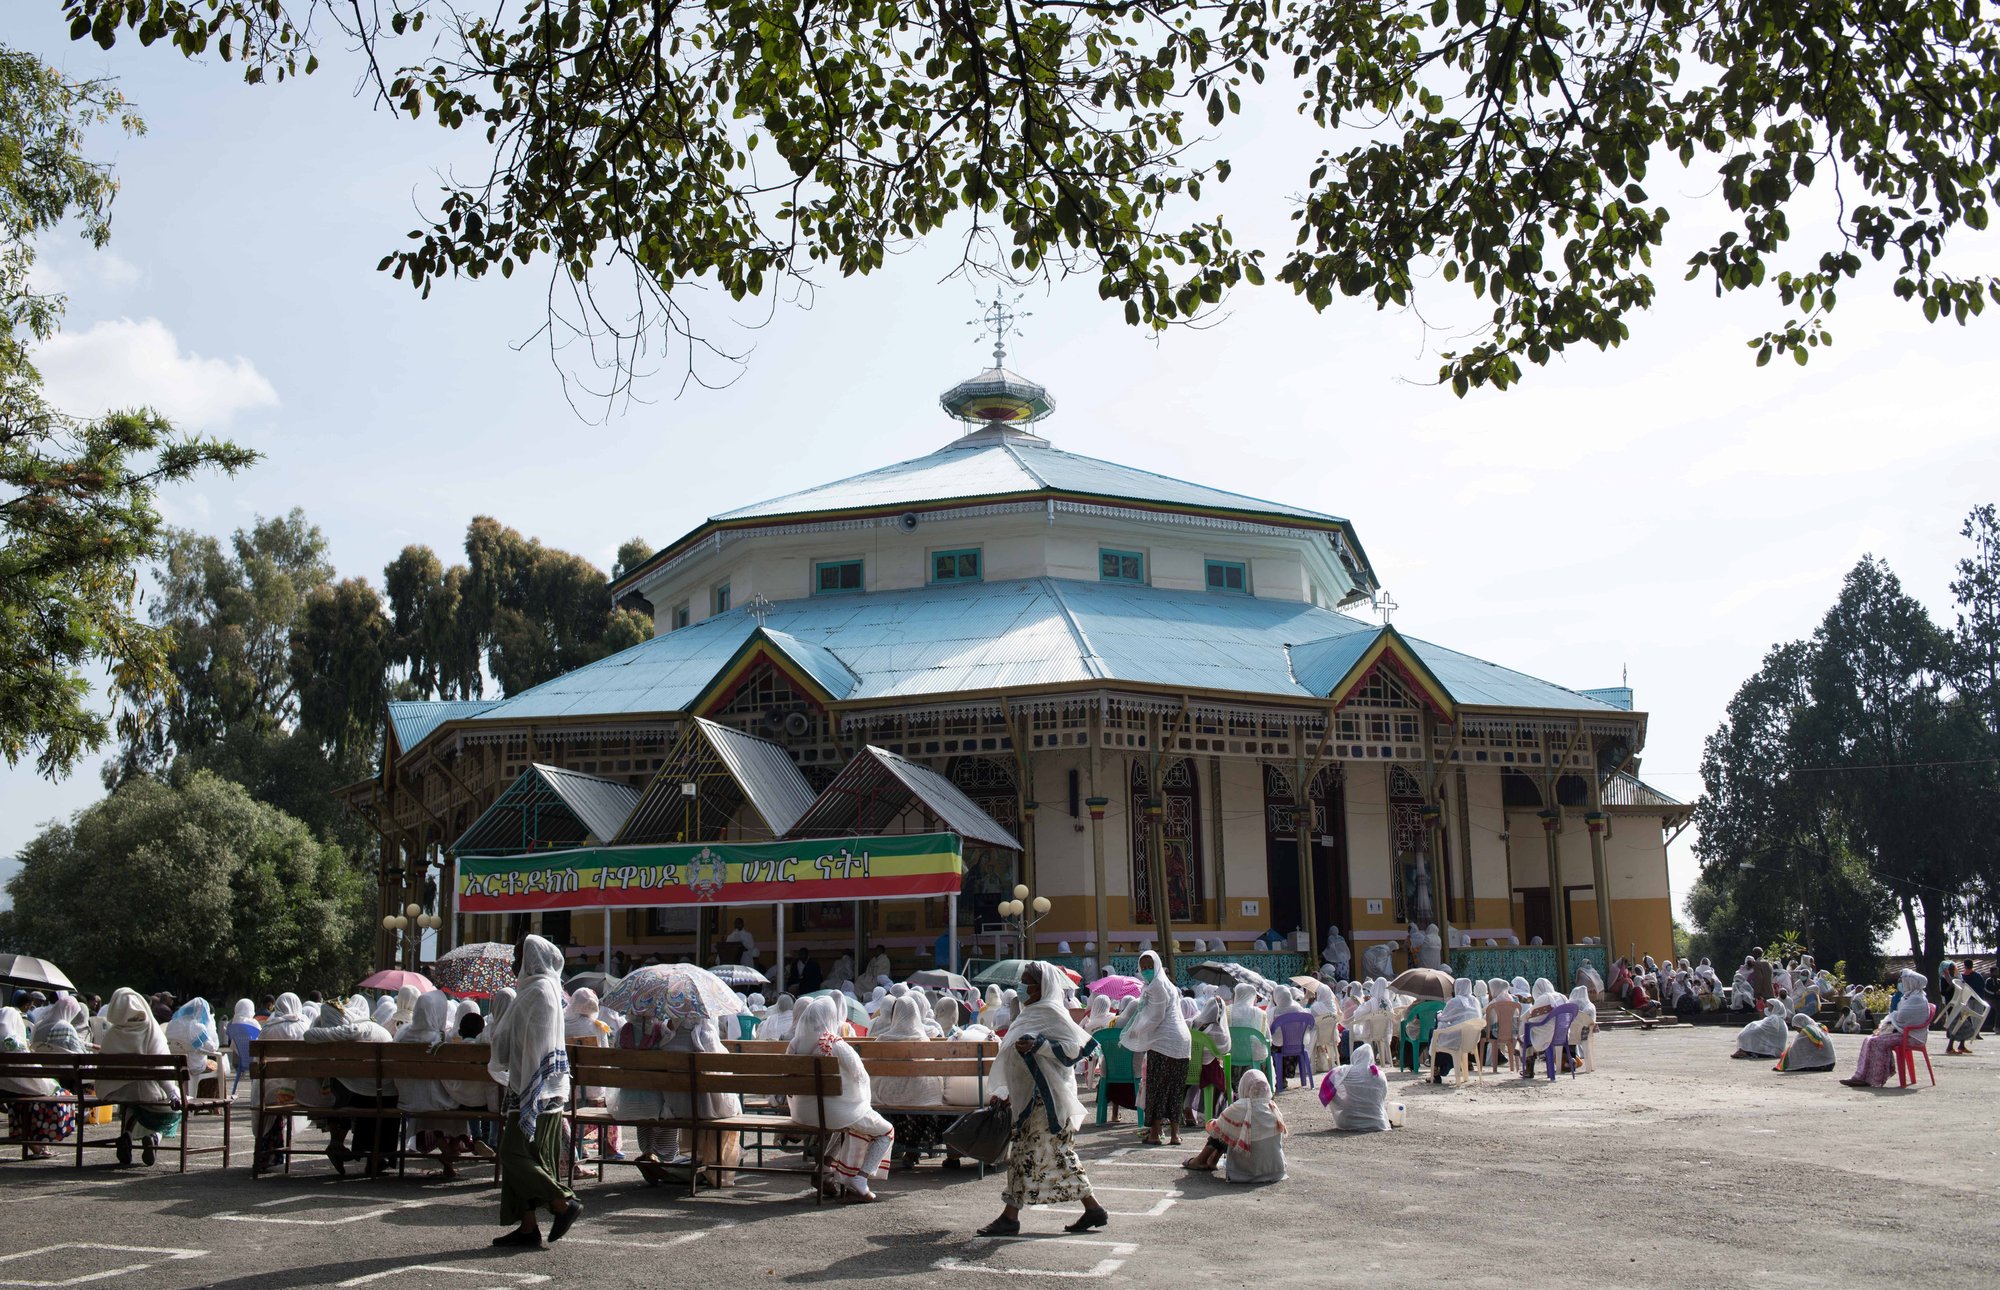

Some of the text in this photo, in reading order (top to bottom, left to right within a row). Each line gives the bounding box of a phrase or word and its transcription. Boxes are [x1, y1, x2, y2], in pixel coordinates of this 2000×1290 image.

[592, 864, 681, 890] ተዋህዶ
[741, 856, 799, 883] ሀገር
[814, 848, 870, 880] ናት!
